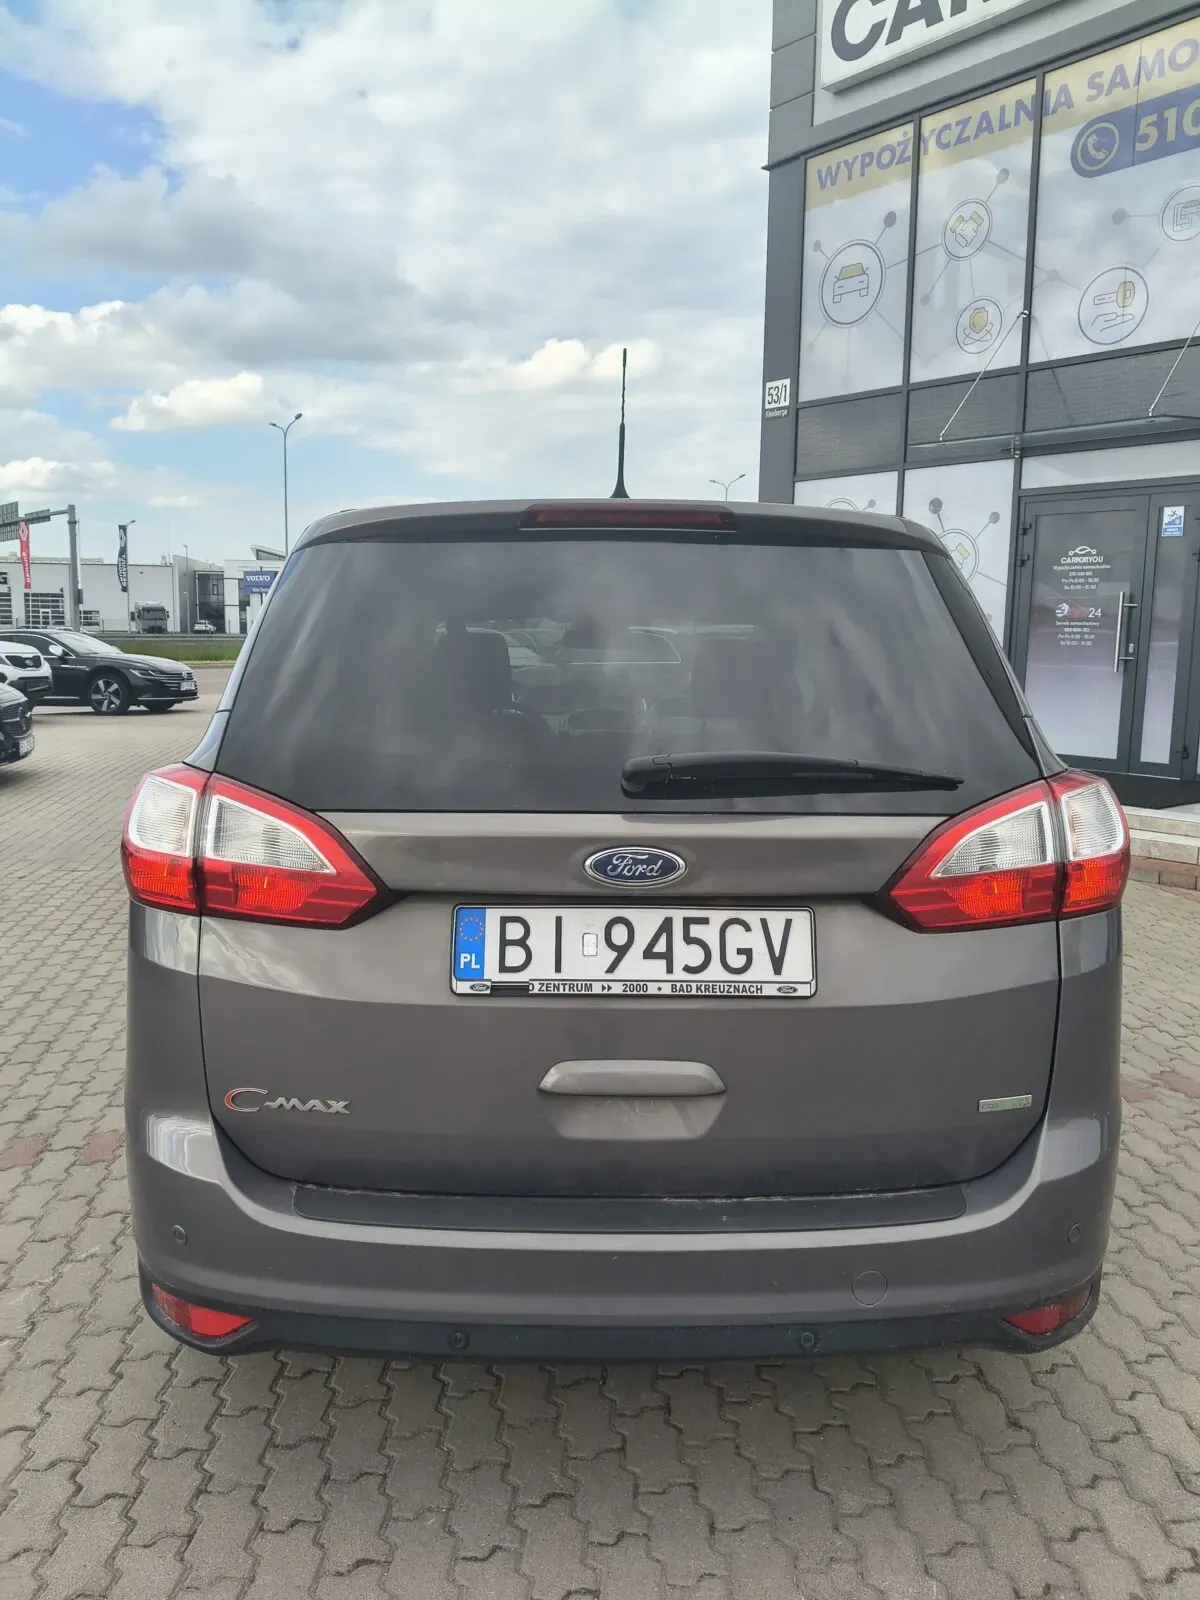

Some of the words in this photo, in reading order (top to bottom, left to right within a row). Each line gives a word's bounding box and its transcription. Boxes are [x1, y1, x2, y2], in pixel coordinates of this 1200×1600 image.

[816, 83, 1074, 190] WYPOŻYCZALNIA
[767, 383, 787, 405] 53/1
[1087, 607, 1103, 618] 24
[607, 853, 663, 876] Ford
[498, 916, 562, 974] BI
[604, 916, 793, 976] 945GV
[460, 953, 480, 969] PL
[538, 983, 593, 993] ZENTRUM
[622, 983, 649, 993] 2000
[670, 984, 693, 994] BAD
[695, 984, 763, 994] KREUZNACH
